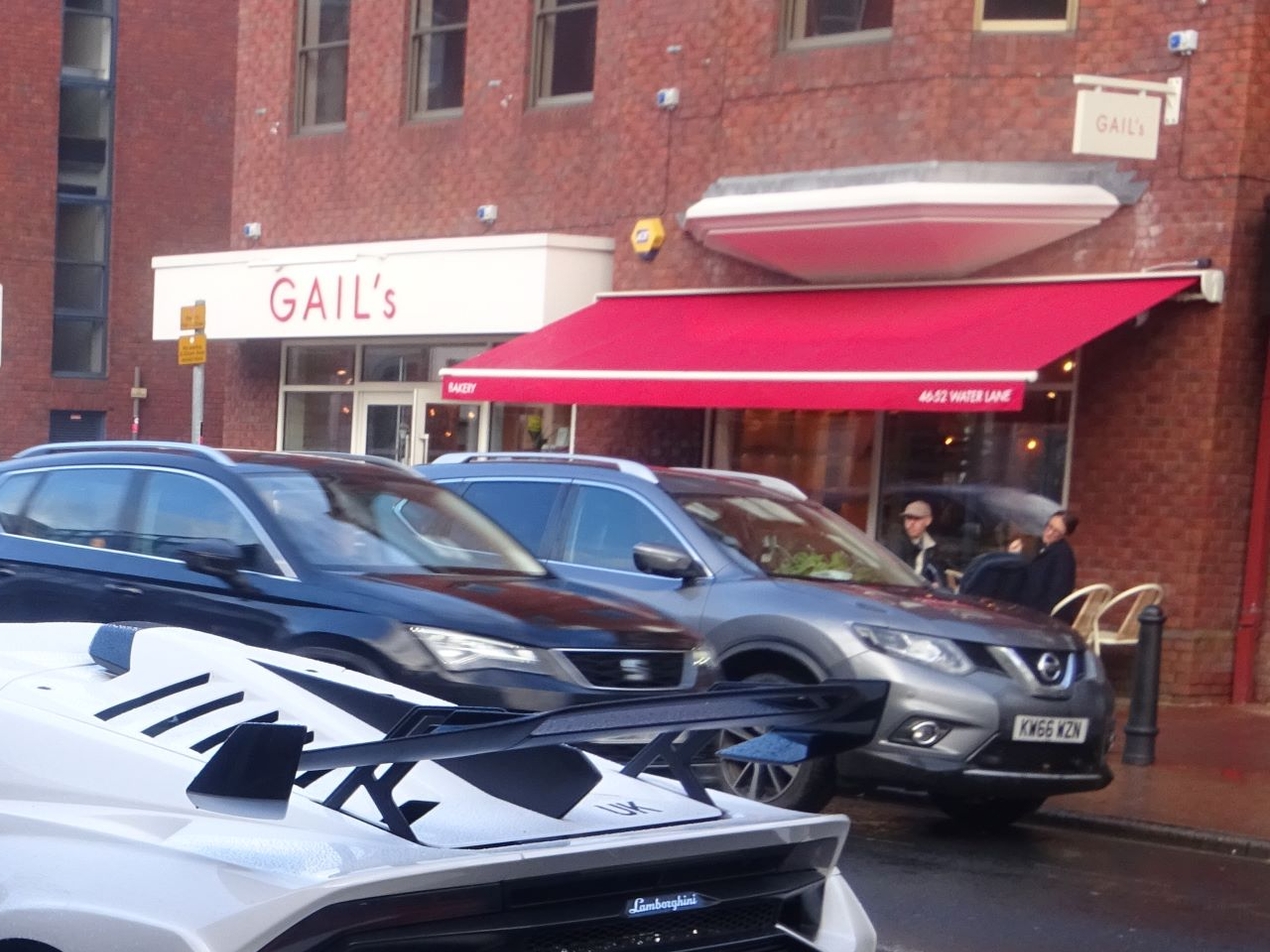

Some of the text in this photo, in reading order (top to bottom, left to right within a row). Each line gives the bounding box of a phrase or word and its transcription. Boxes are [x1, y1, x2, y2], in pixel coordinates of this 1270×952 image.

[1095, 114, 1145, 137] GAIL's
[270, 273, 396, 323] GAIL's
[447, 381, 477, 394] BAKERY
[949, 388, 984, 403] WATER
[985, 387, 1013, 403] LANE
[1019, 718, 1082, 739] KW66 WZN
[594, 801, 662, 815] UK
[628, 894, 698, 914] Lamborghini
